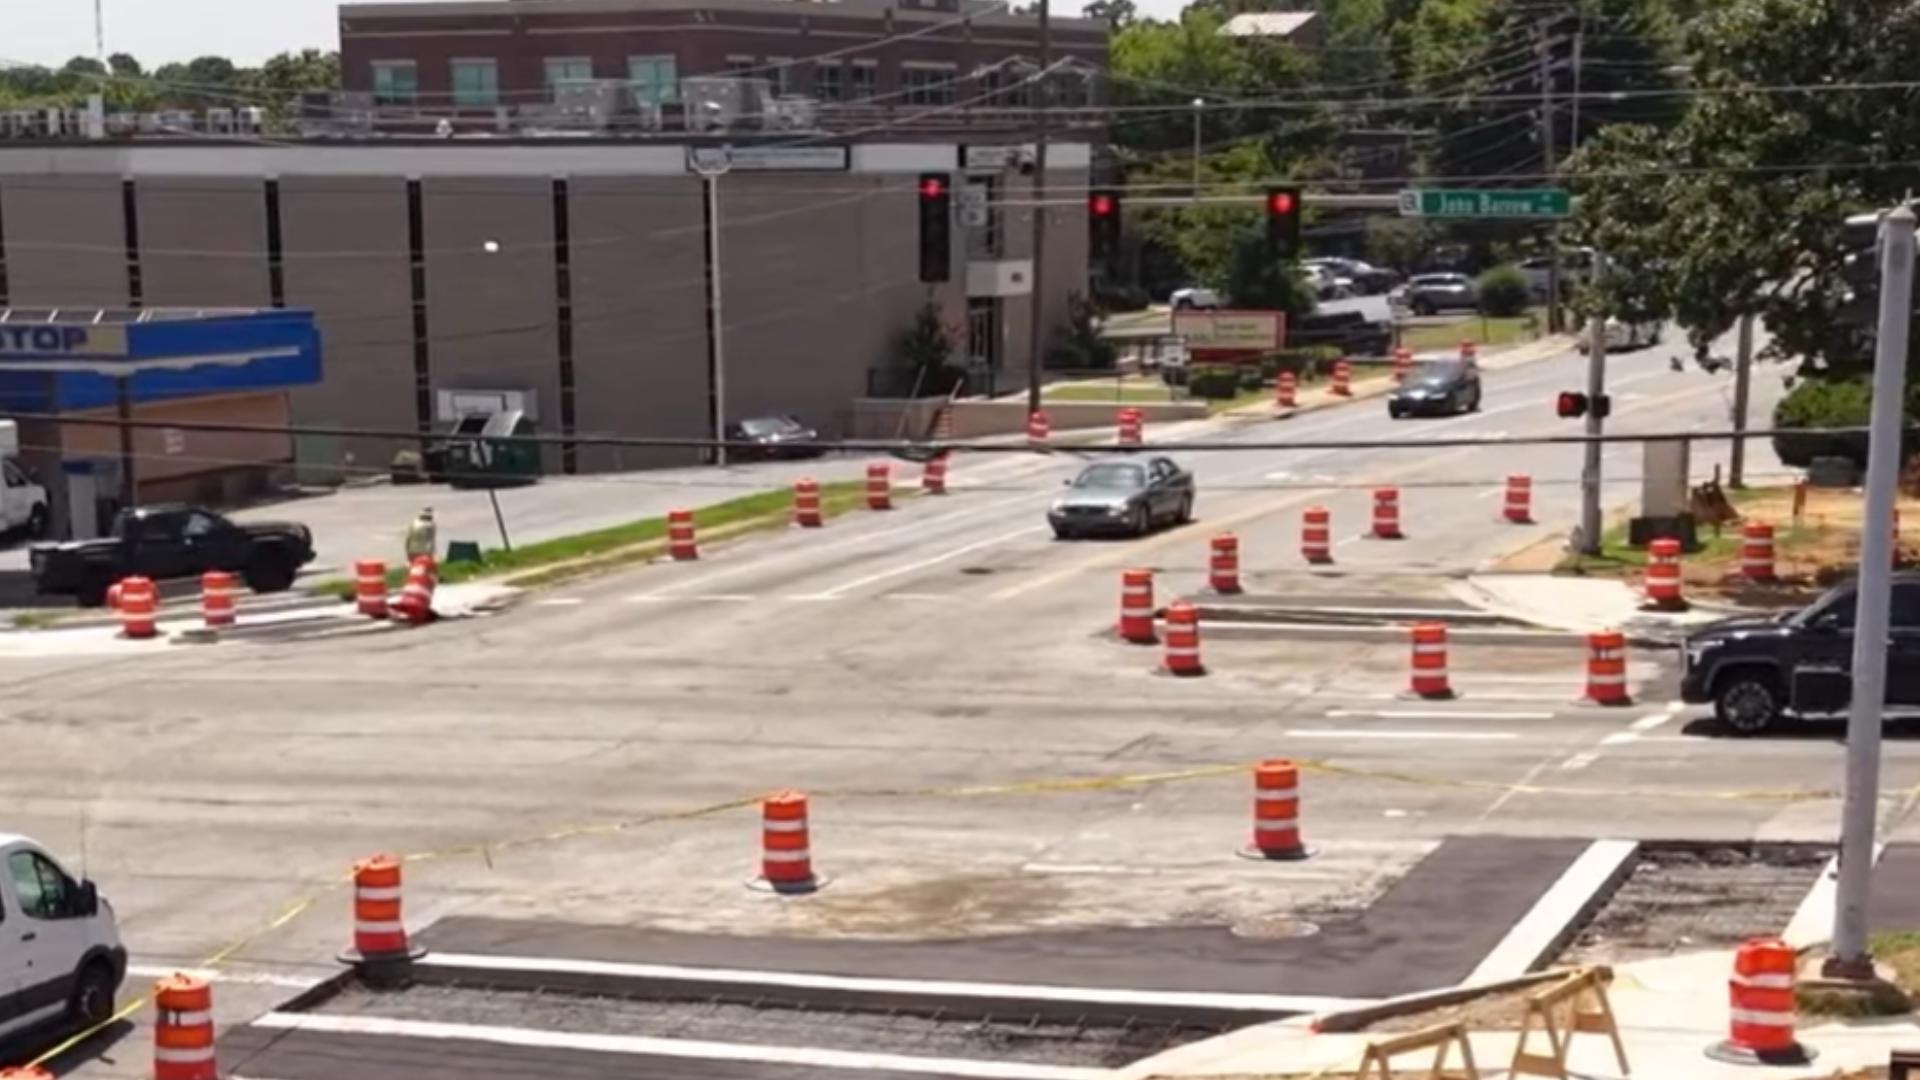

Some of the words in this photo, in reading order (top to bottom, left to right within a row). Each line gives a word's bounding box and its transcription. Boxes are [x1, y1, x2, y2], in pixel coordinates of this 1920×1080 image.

[1440, 193, 1474, 213] John
[1479, 193, 1532, 213] Barrow
[0, 325, 88, 351] TOP
